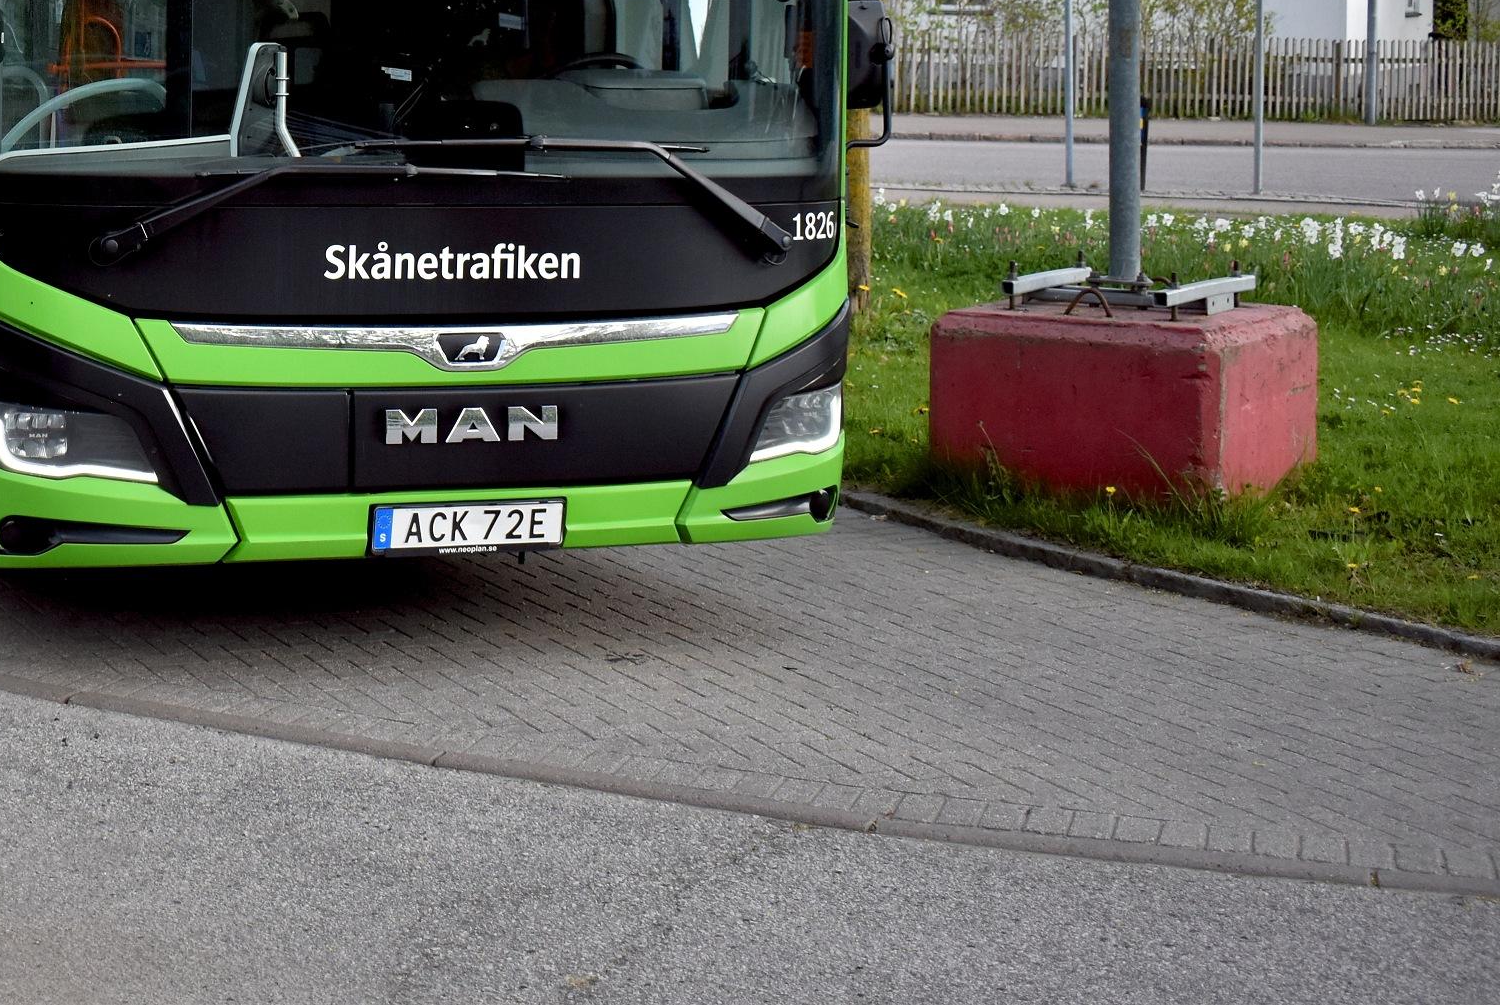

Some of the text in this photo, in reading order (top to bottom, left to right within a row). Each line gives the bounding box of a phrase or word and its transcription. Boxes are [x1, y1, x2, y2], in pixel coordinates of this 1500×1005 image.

[791, 211, 835, 241] 1826
[323, 242, 582, 281] Skånetrafiken
[385, 404, 559, 445] MAN
[379, 532, 387, 543] S
[404, 508, 547, 544] ACK 72E
[438, 545, 498, 554] www.neoplan.se
